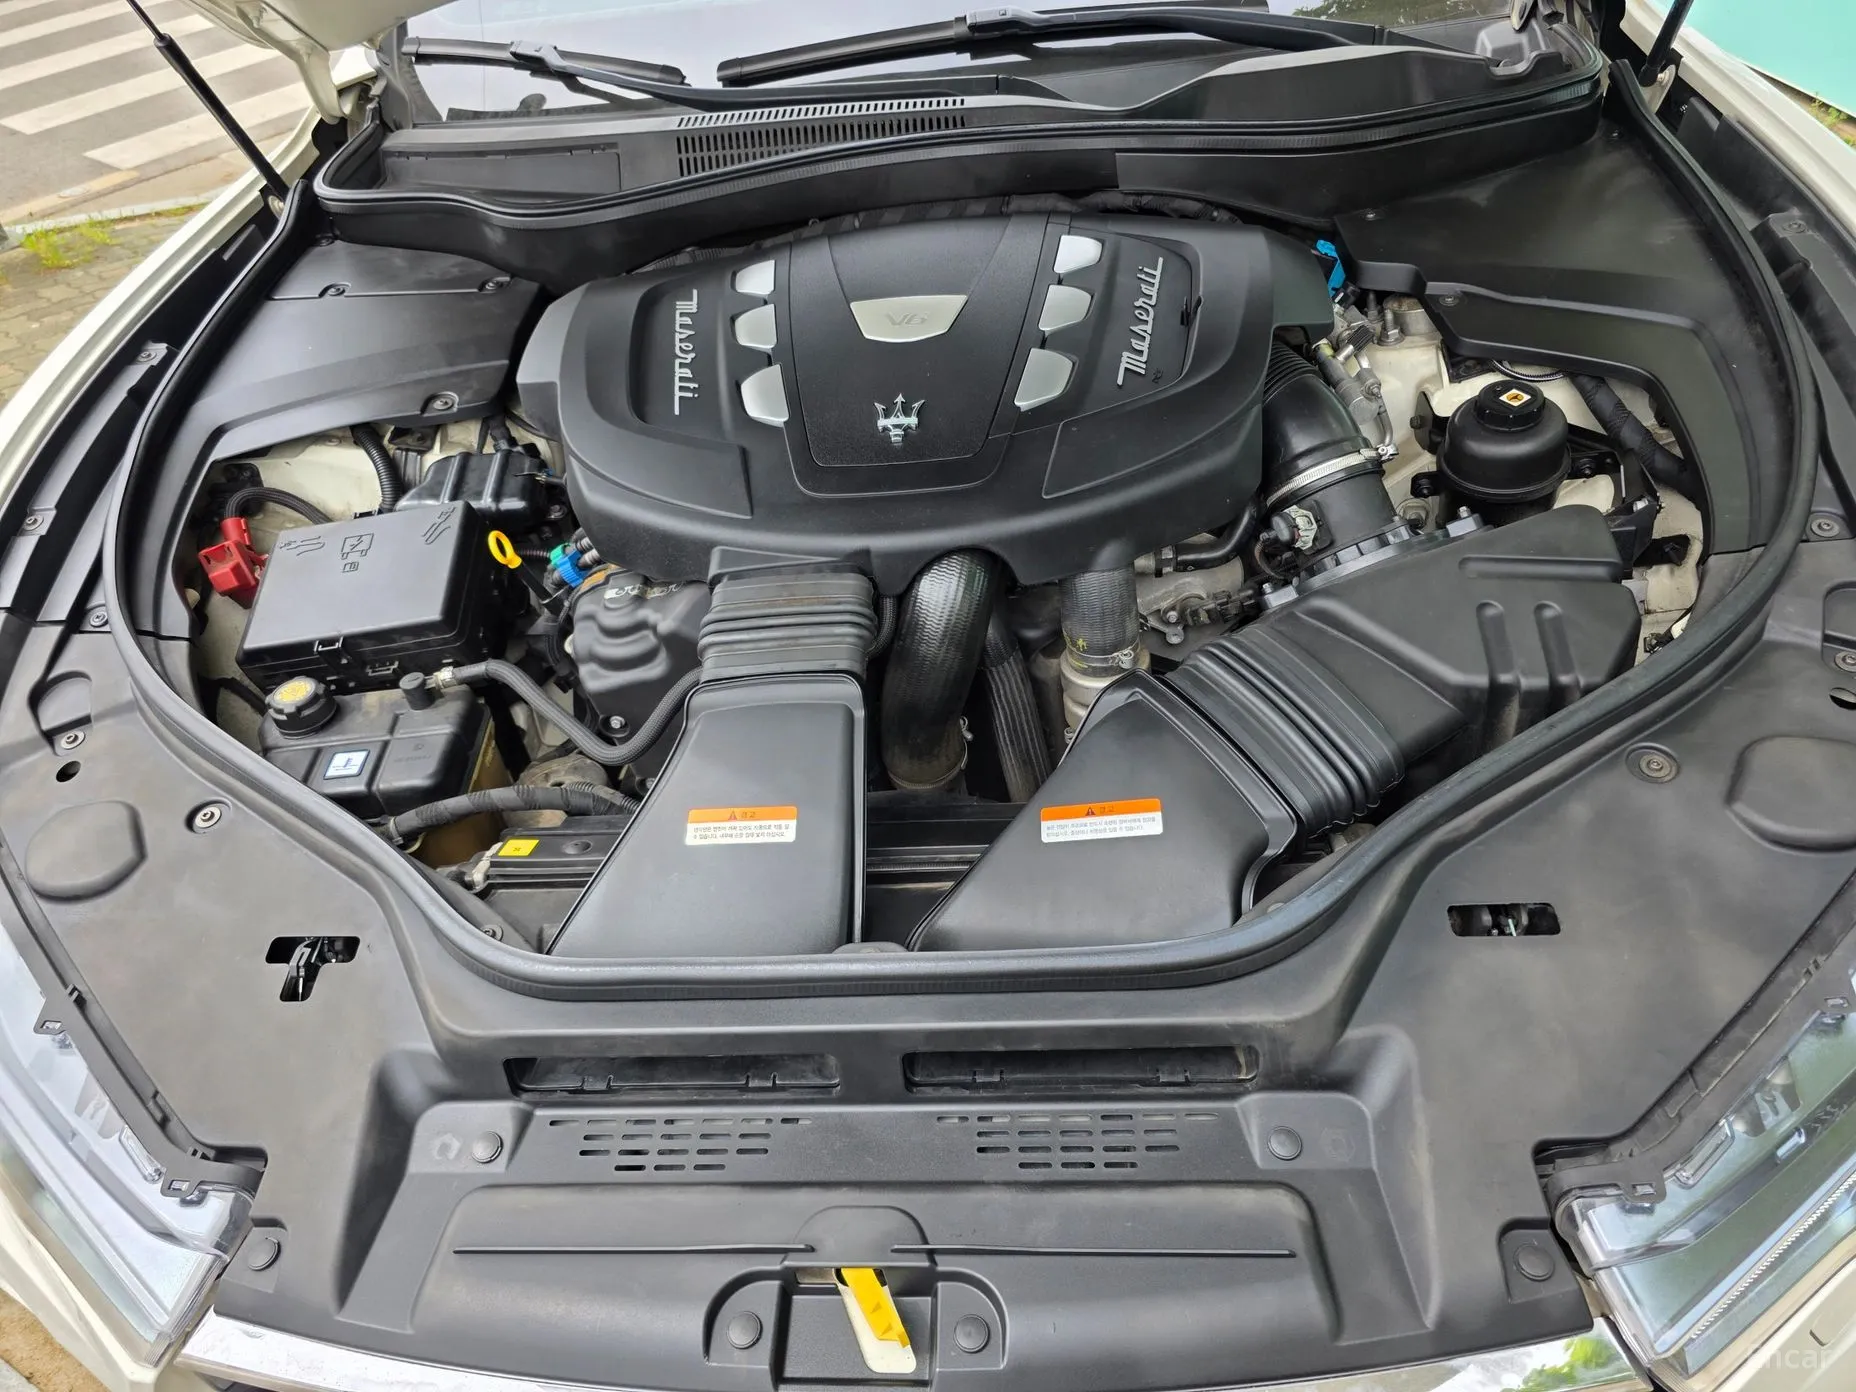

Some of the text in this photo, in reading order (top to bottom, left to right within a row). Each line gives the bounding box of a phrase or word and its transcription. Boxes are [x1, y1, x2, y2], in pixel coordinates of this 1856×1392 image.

[674, 288, 699, 416] Maserati
[885, 311, 930, 326] V6
[1116, 256, 1164, 386] Maserati
